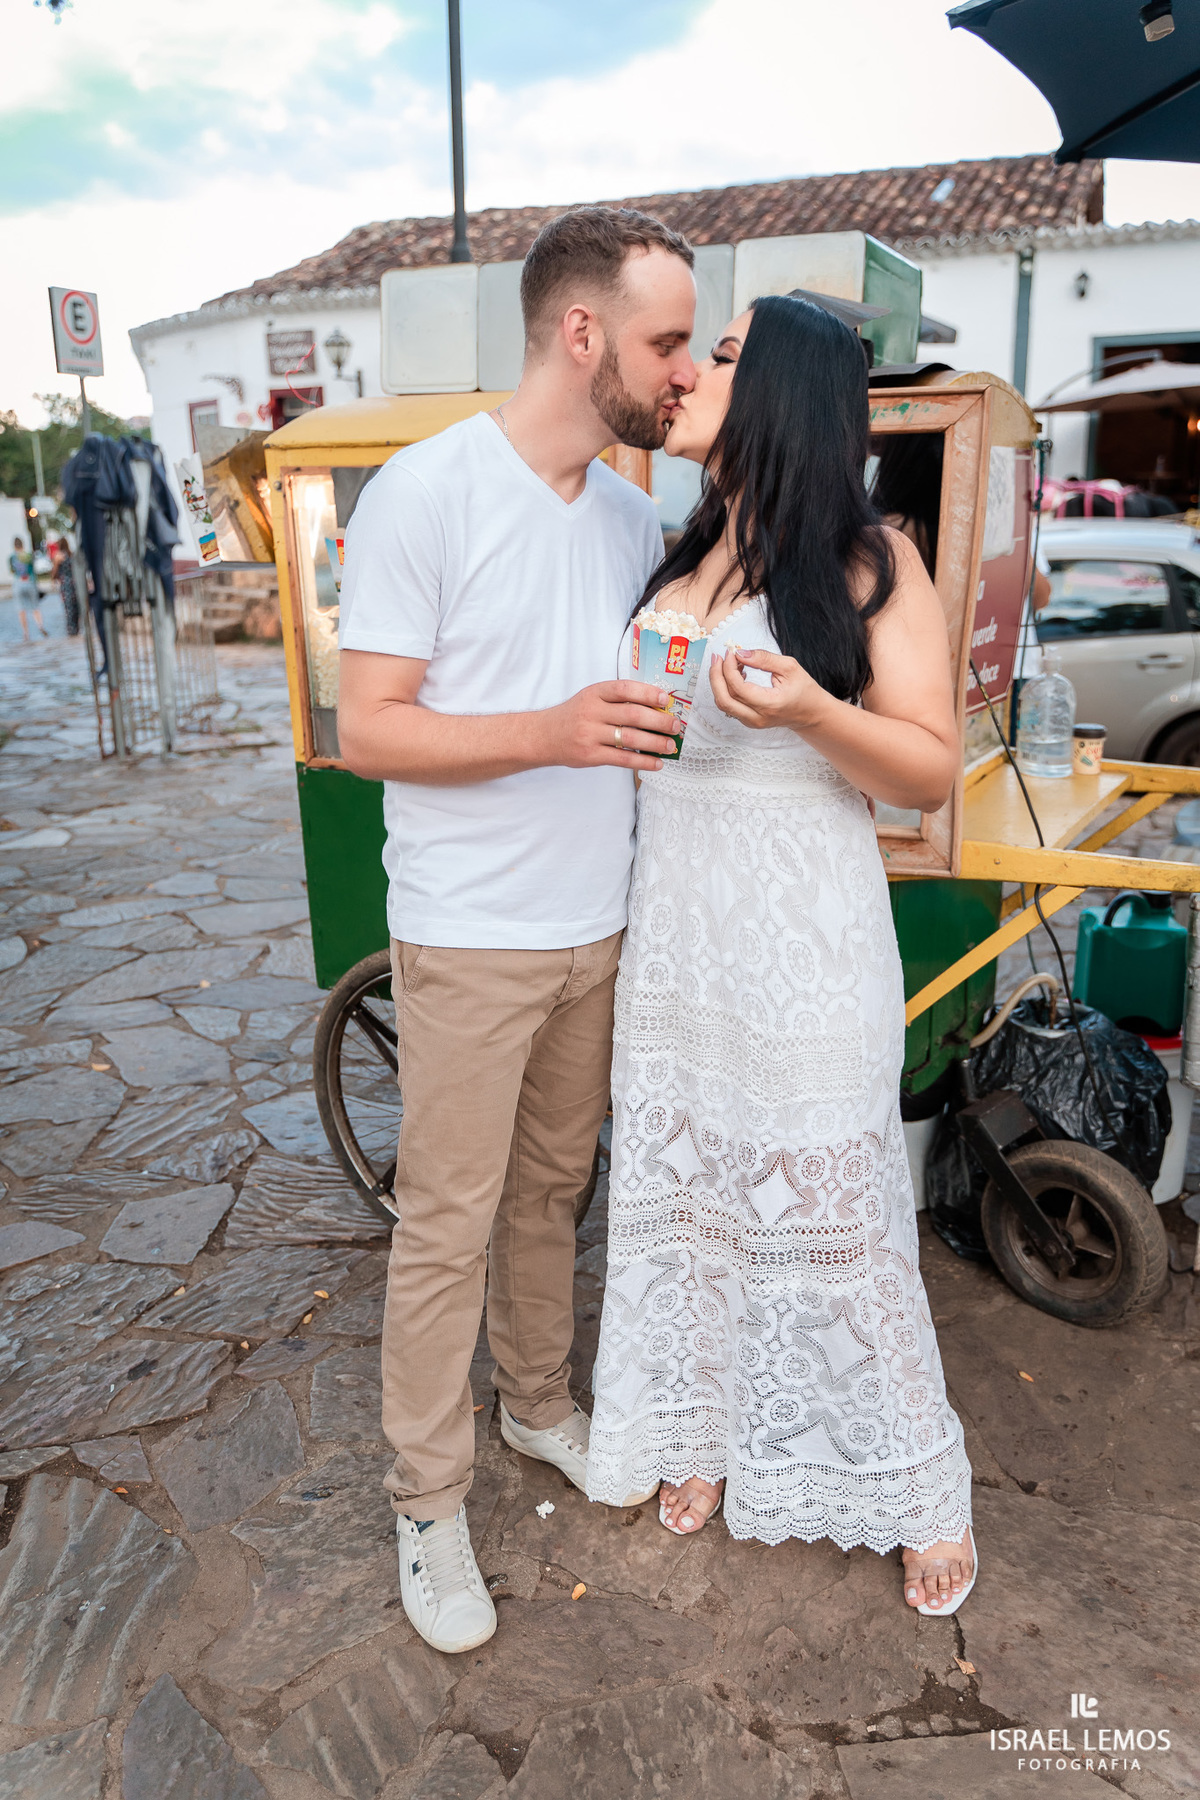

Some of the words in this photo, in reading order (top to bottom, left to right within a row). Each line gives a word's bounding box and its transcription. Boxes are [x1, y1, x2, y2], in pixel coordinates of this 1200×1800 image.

[71, 302, 86, 332] E
[972, 616, 998, 648] verde
[980, 662, 1000, 684] doce
